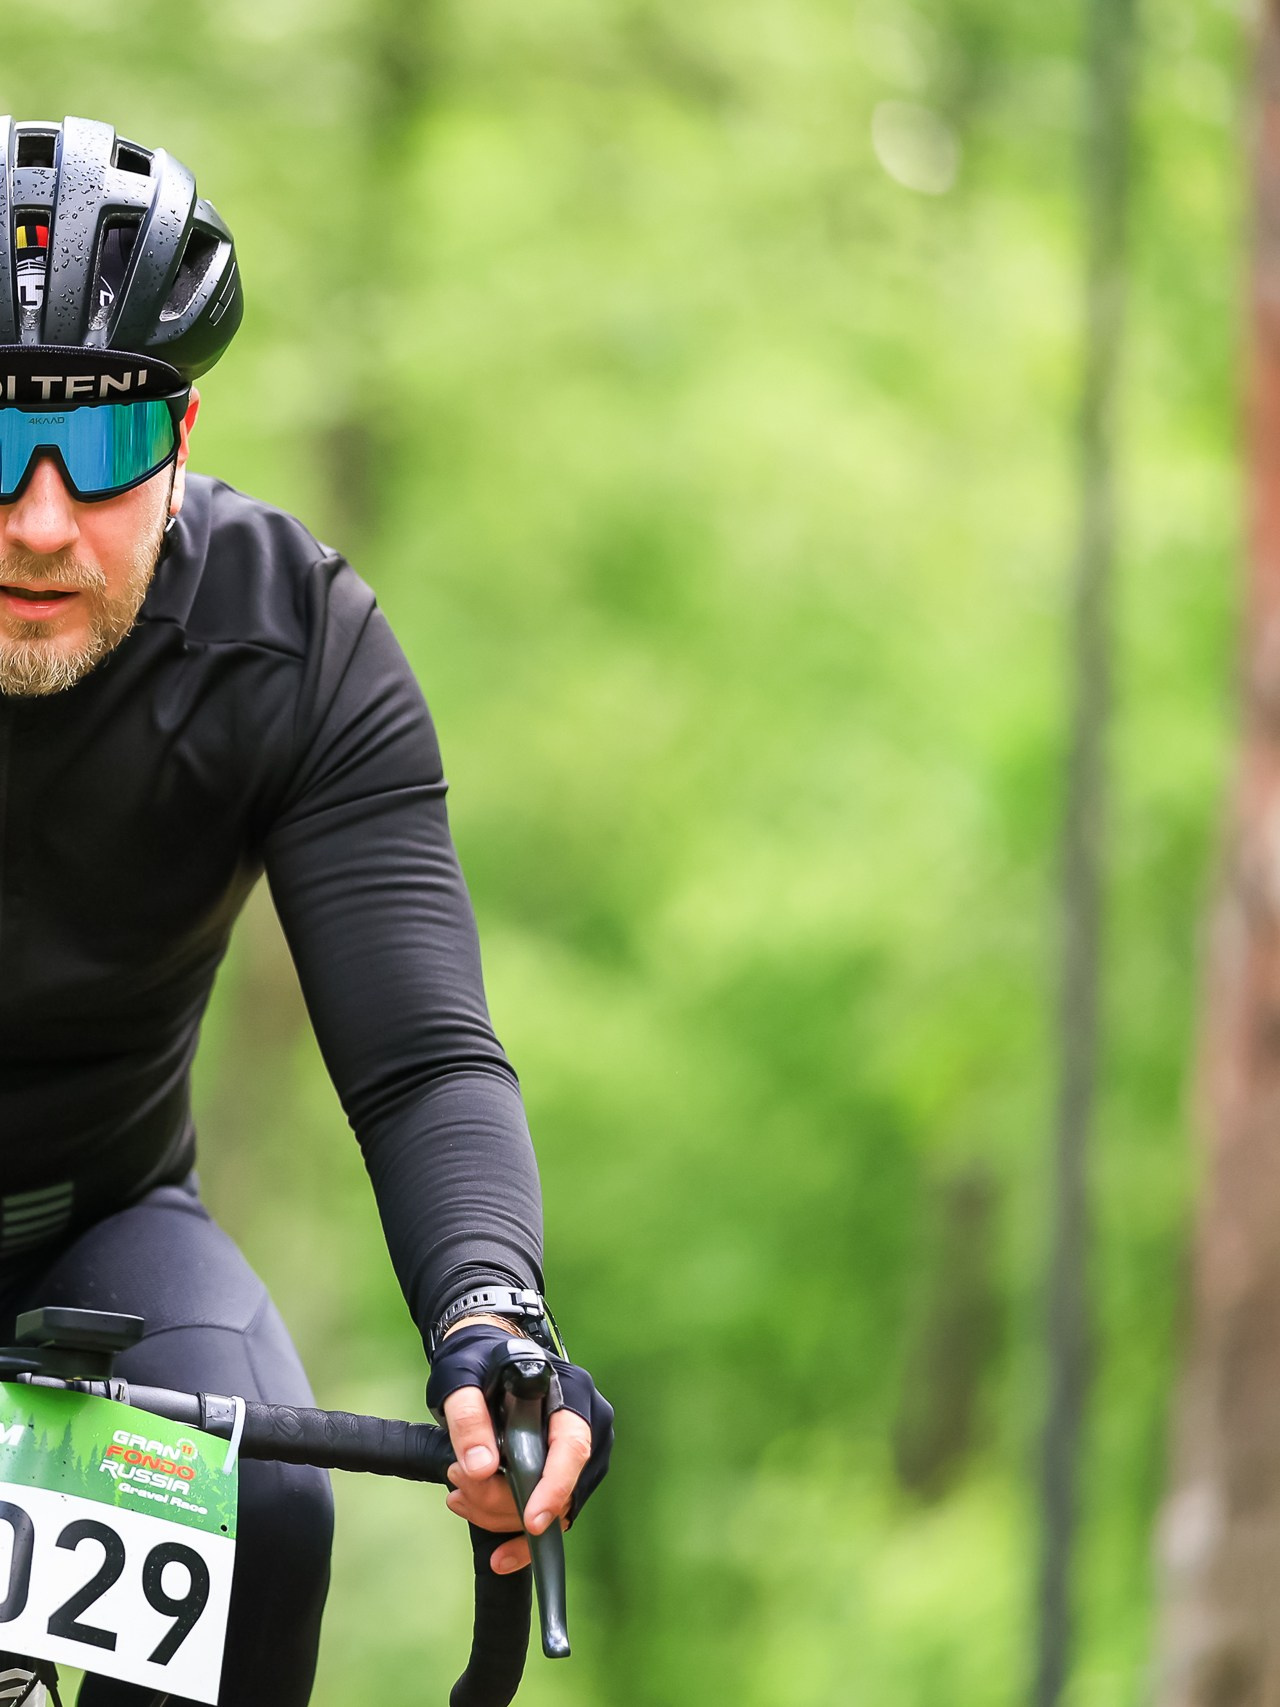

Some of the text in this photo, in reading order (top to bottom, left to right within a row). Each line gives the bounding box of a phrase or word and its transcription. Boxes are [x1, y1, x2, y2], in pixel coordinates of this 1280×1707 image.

[112, 1430, 180, 1460] GRAN
[99, 1459, 190, 1495] RUSSIA
[106, 1445, 195, 1481] FONDO
[118, 1482, 208, 1515] Gravel Race
